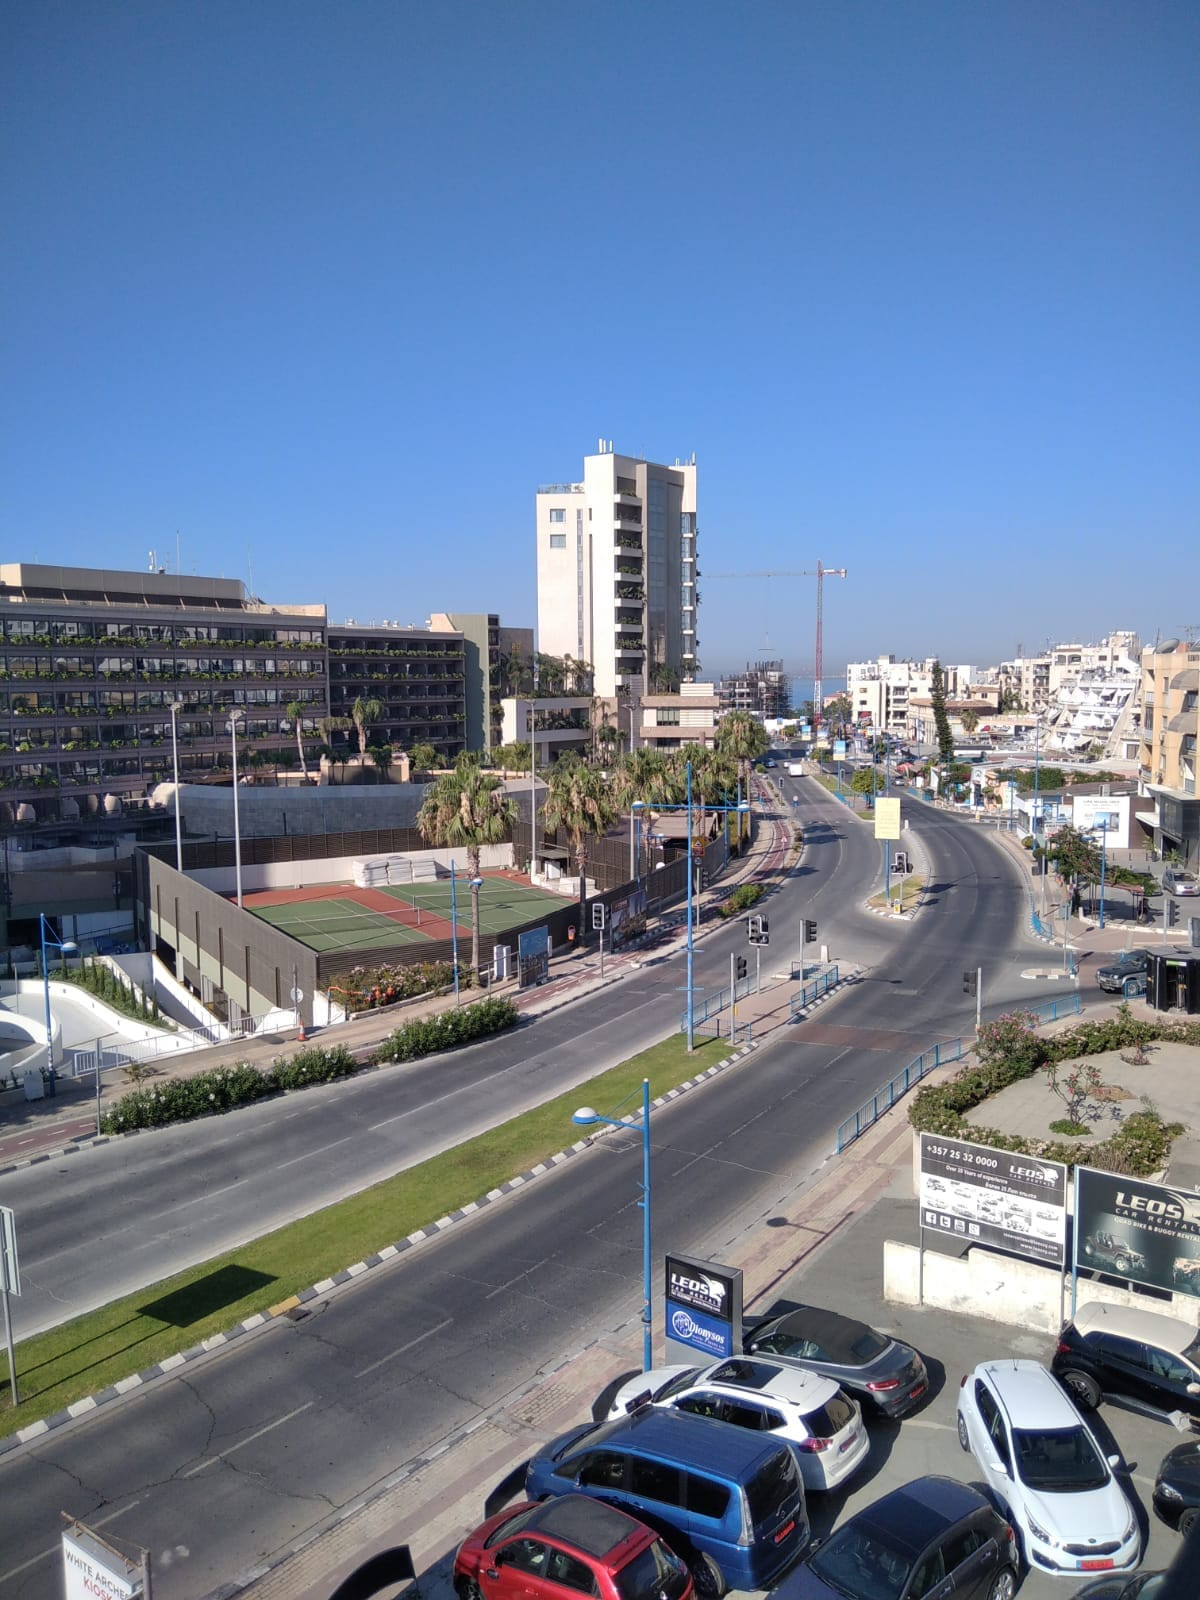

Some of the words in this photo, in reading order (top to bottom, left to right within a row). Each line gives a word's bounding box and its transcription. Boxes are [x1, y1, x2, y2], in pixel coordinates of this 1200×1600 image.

[927, 1144, 947, 1156] +357
[950, 1150, 960, 1159] 25
[963, 1153, 973, 1163] 32
[976, 1156, 998, 1168] 0000
[1010, 1165, 1044, 1179] LEOS
[1115, 1191, 1182, 1220] LEOS
[1115, 1208, 1138, 1217] CAR
[1148, 1215, 1200, 1232] RENTAL
[1133, 1222, 1147, 1230] BIKE
[1153, 1226, 1176, 1237] BUGGY
[671, 1273, 709, 1295] LEOS
[690, 1322, 725, 1344] Dionysos
[65, 1549, 93, 1577] WHITE
